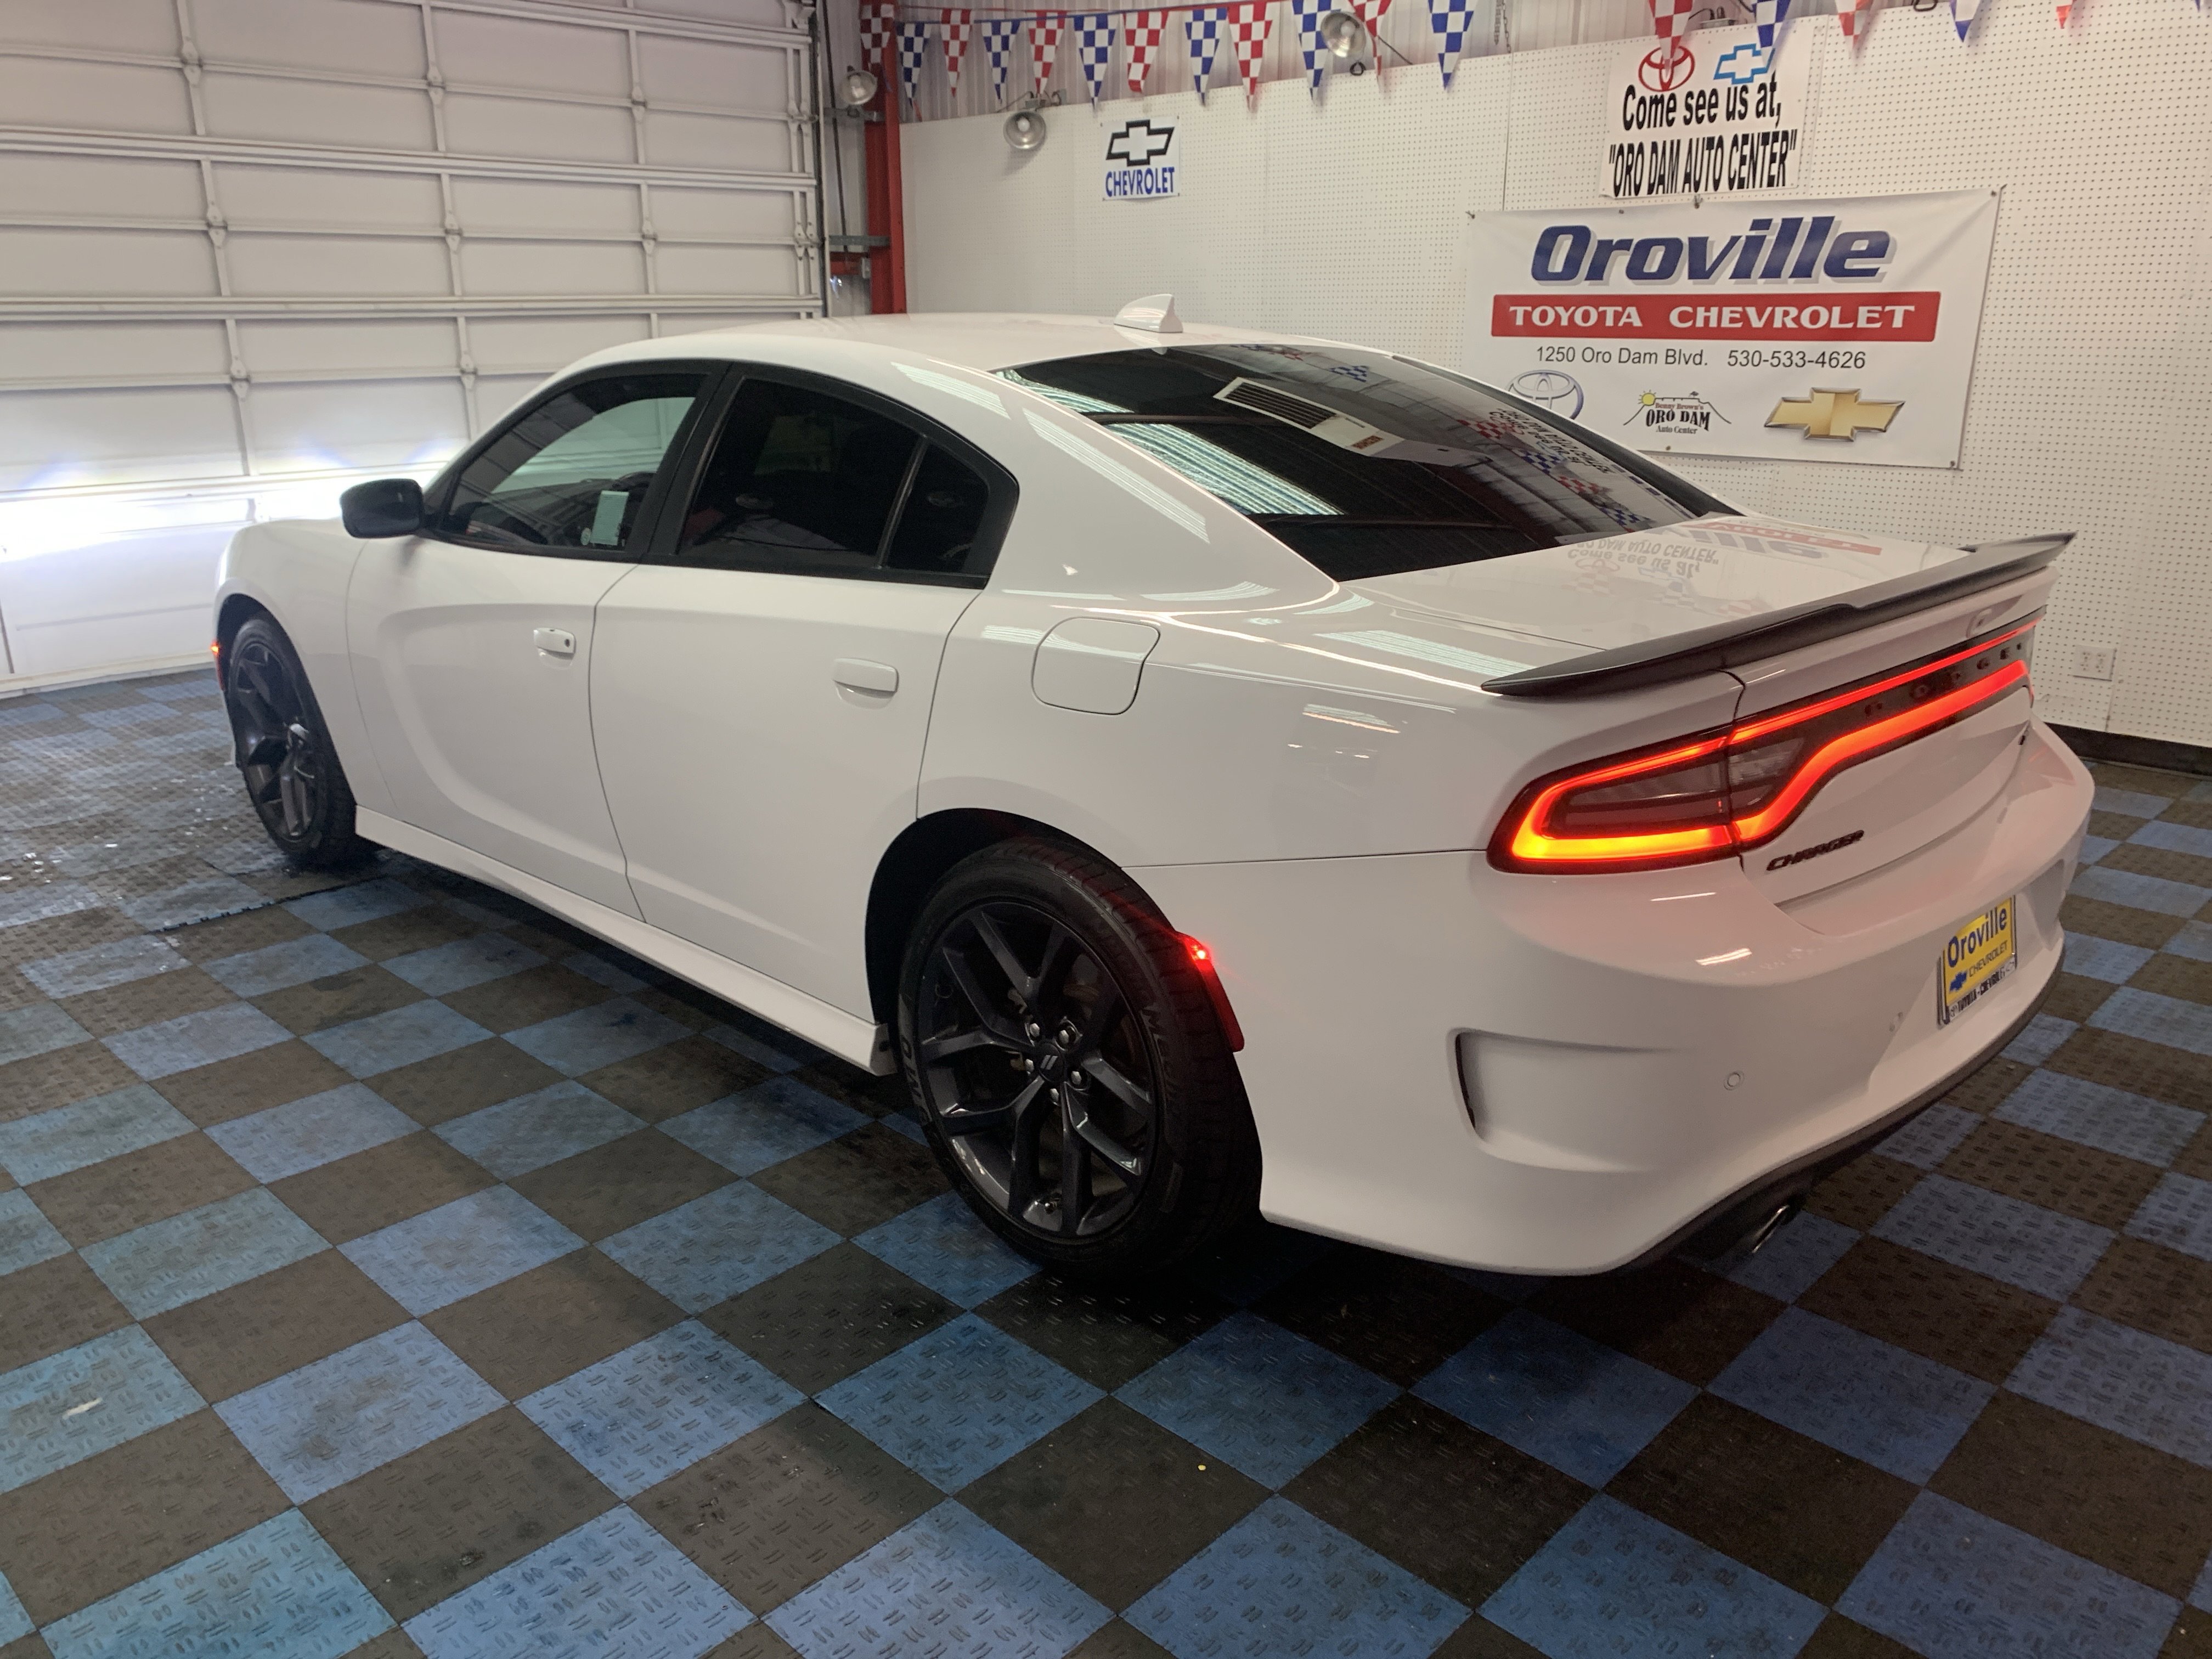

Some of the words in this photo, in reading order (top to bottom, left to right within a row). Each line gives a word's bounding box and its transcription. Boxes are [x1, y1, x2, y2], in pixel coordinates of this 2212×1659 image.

[1623, 84, 1677, 131] Come
[1683, 88, 1719, 126] see
[1725, 84, 1749, 122] us
[1756, 69, 1781, 129] at,
[1609, 141, 1644, 198] "ORO
[1647, 139, 1680, 195] DAM
[1681, 135, 1724, 193] AUTO
[1728, 129, 1798, 191] CENTER"
[1105, 166, 1175, 198] CHEVROLET
[1530, 215, 1893, 284] Oroville
[1508, 305, 1643, 329] TOYOTA
[1668, 304, 1916, 329] CHEVROLET
[1536, 346, 1576, 363] 1250
[1581, 347, 1612, 364] Oro
[1618, 347, 1658, 365] Dam
[1664, 348, 1708, 366] Blvd.
[1727, 349, 1866, 369] 530-533-4626
[1646, 409, 1675, 427] ORO
[1679, 410, 1711, 432] DAM
[1674, 426, 1697, 434] Center
[1948, 908, 2007, 968] Oroville
[1969, 940, 2008, 978] CHEVROLET
